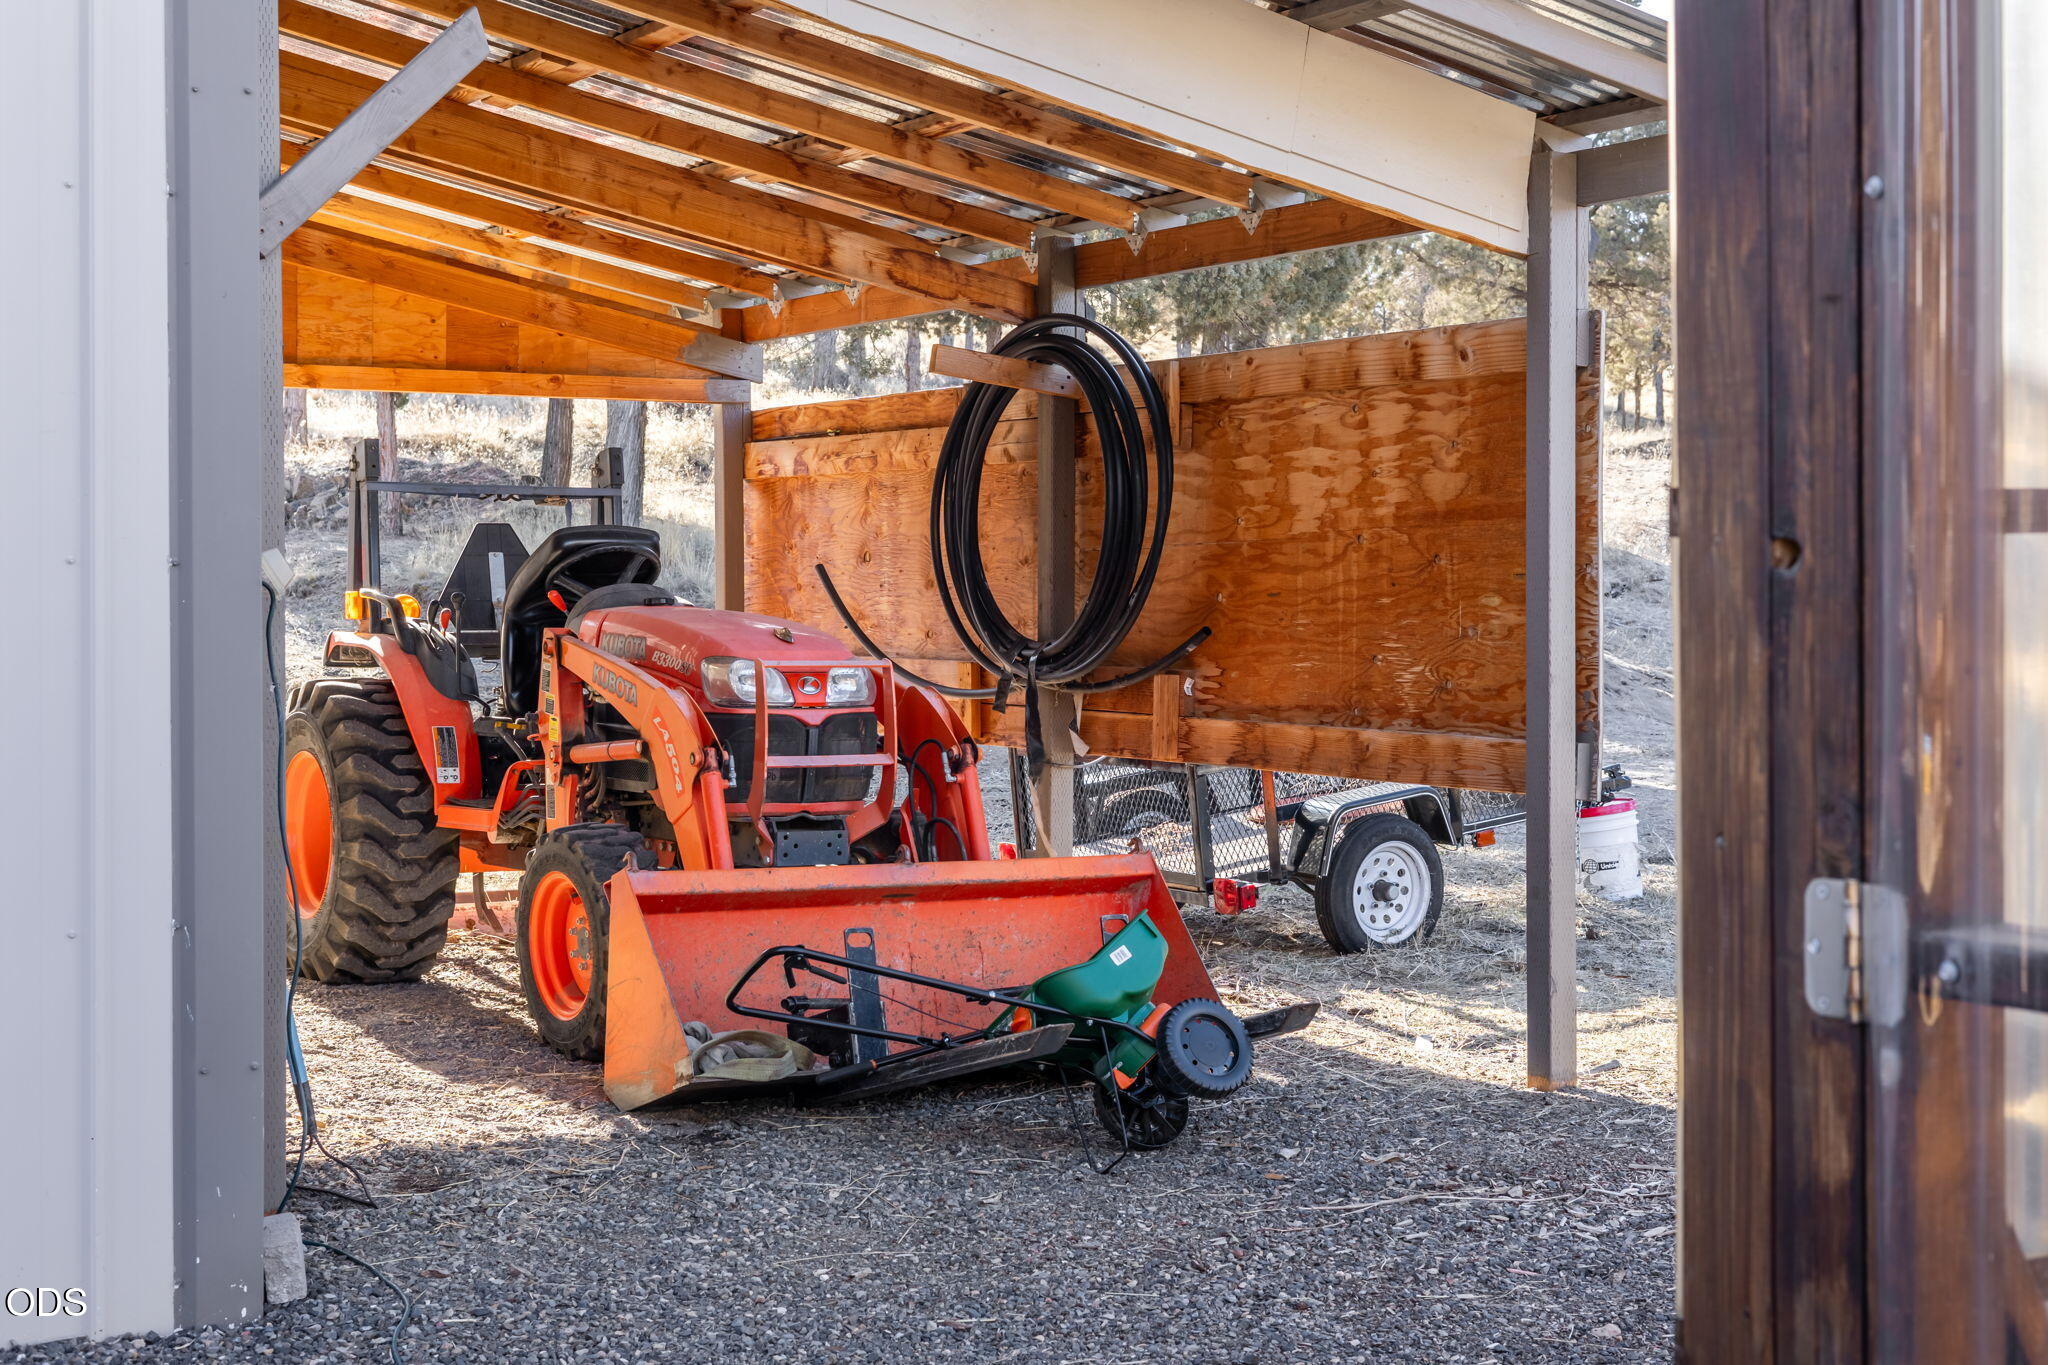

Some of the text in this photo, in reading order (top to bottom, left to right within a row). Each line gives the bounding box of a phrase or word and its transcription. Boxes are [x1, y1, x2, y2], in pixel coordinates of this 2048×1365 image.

[601, 632, 647, 661] KUBOTA
[593, 663, 638, 708] KUBOTA
[653, 716, 682, 793] LA504
